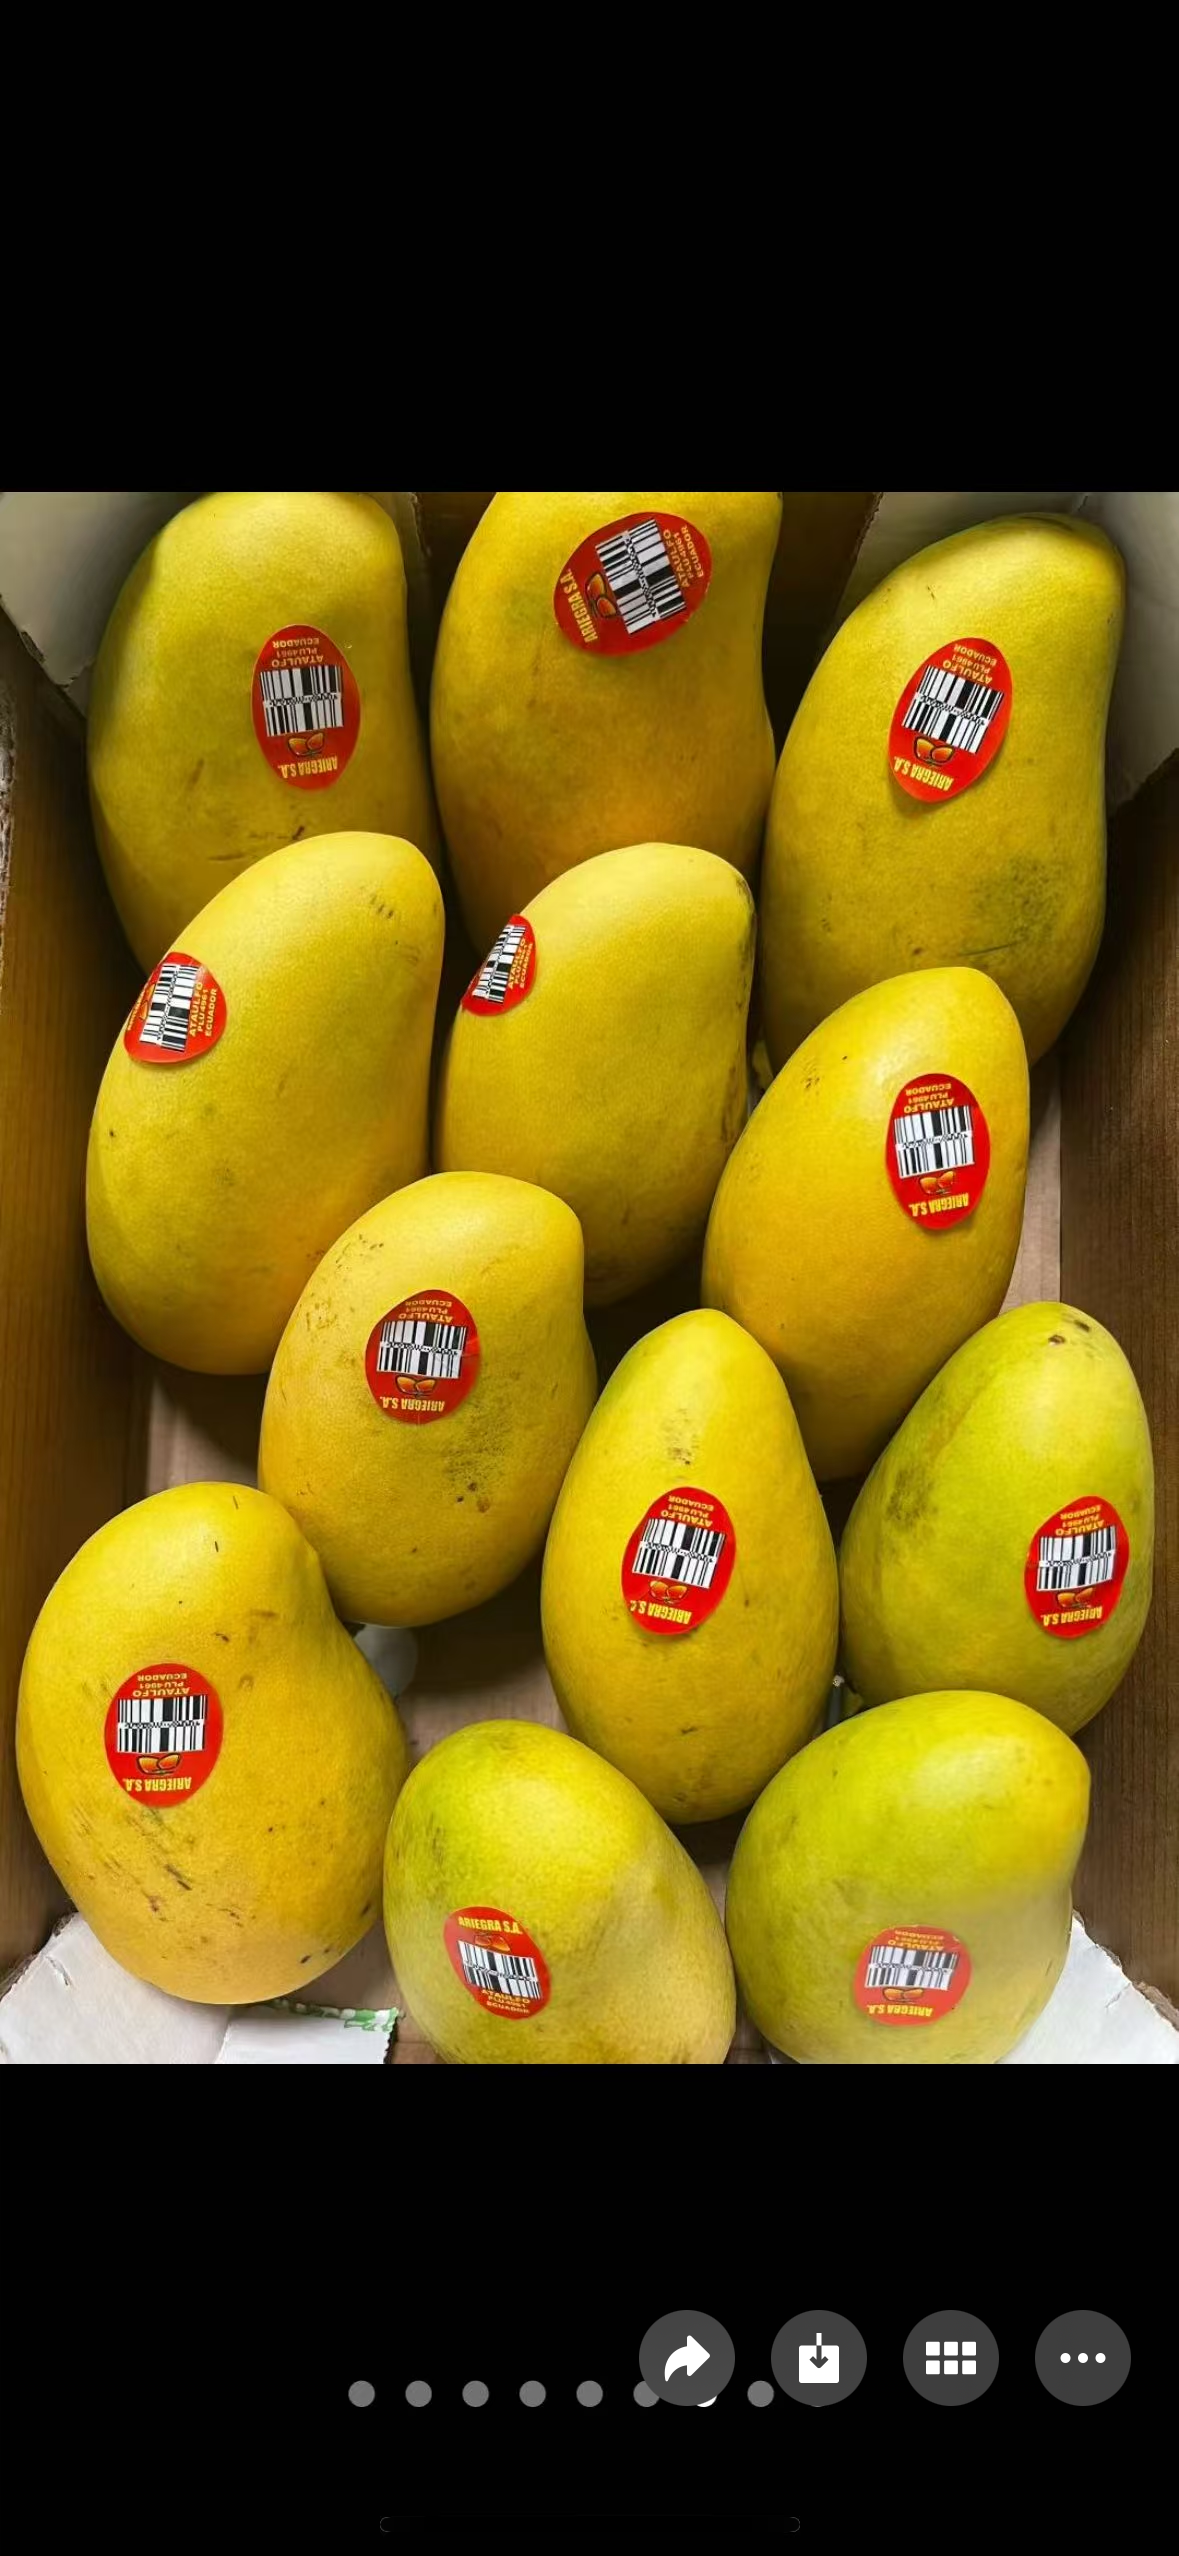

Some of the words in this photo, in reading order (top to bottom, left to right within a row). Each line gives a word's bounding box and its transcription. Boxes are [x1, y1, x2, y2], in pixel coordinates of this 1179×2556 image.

[663, 529, 690, 588] ATAULFO
[681, 525, 704, 578] ECUADOR
[684, 559, 693, 578] PLU
[568, 594, 598, 643] ARIEGRA
[272, 637, 320, 649] ECUADOR
[300, 648, 317, 656] PLU
[954, 644, 997, 666] ECUADOR
[271, 655, 324, 668] ATAULFO
[973, 662, 990, 674] PLU
[943, 659, 993, 685] ATAULFO
[300, 756, 338, 775] ARIEGRA
[910, 764, 954, 791] ARIEGRA
[189, 982, 203, 1037] ATAULFO
[204, 988, 217, 1037] ECUADOR
[197, 1011, 205, 1032] PLU
[905, 1082, 952, 1097] ECUADOR
[930, 1092, 948, 1102] PLU
[904, 1097, 955, 1114] ATAULFO
[929, 1193, 969, 1214] ARIEGRA
[405, 1299, 452, 1307] ECUADOR
[429, 1306, 448, 1314] PLU
[399, 1312, 453, 1323] ATAULFO
[401, 1398, 445, 1412] ARIEGRA
[668, 1495, 714, 1512] ECUADOR
[661, 1510, 713, 1528] ATAULFO
[690, 1509, 709, 1519] PLU
[1060, 1504, 1101, 1520] ECUADOR
[1083, 1514, 1099, 1525] PLU
[1055, 1519, 1105, 1536] ATAULFO
[648, 1602, 692, 1625] ARIEGRA
[1061, 1606, 1102, 1624] ARIEGRA
[137, 1673, 187, 1681] ECUADOR
[133, 1687, 191, 1698] ATAULFO
[145, 1777, 192, 1792] ARIEGRA
[458, 1916, 502, 1931] ARIEGRA
[887, 2004, 933, 2017] ARIEGRA
